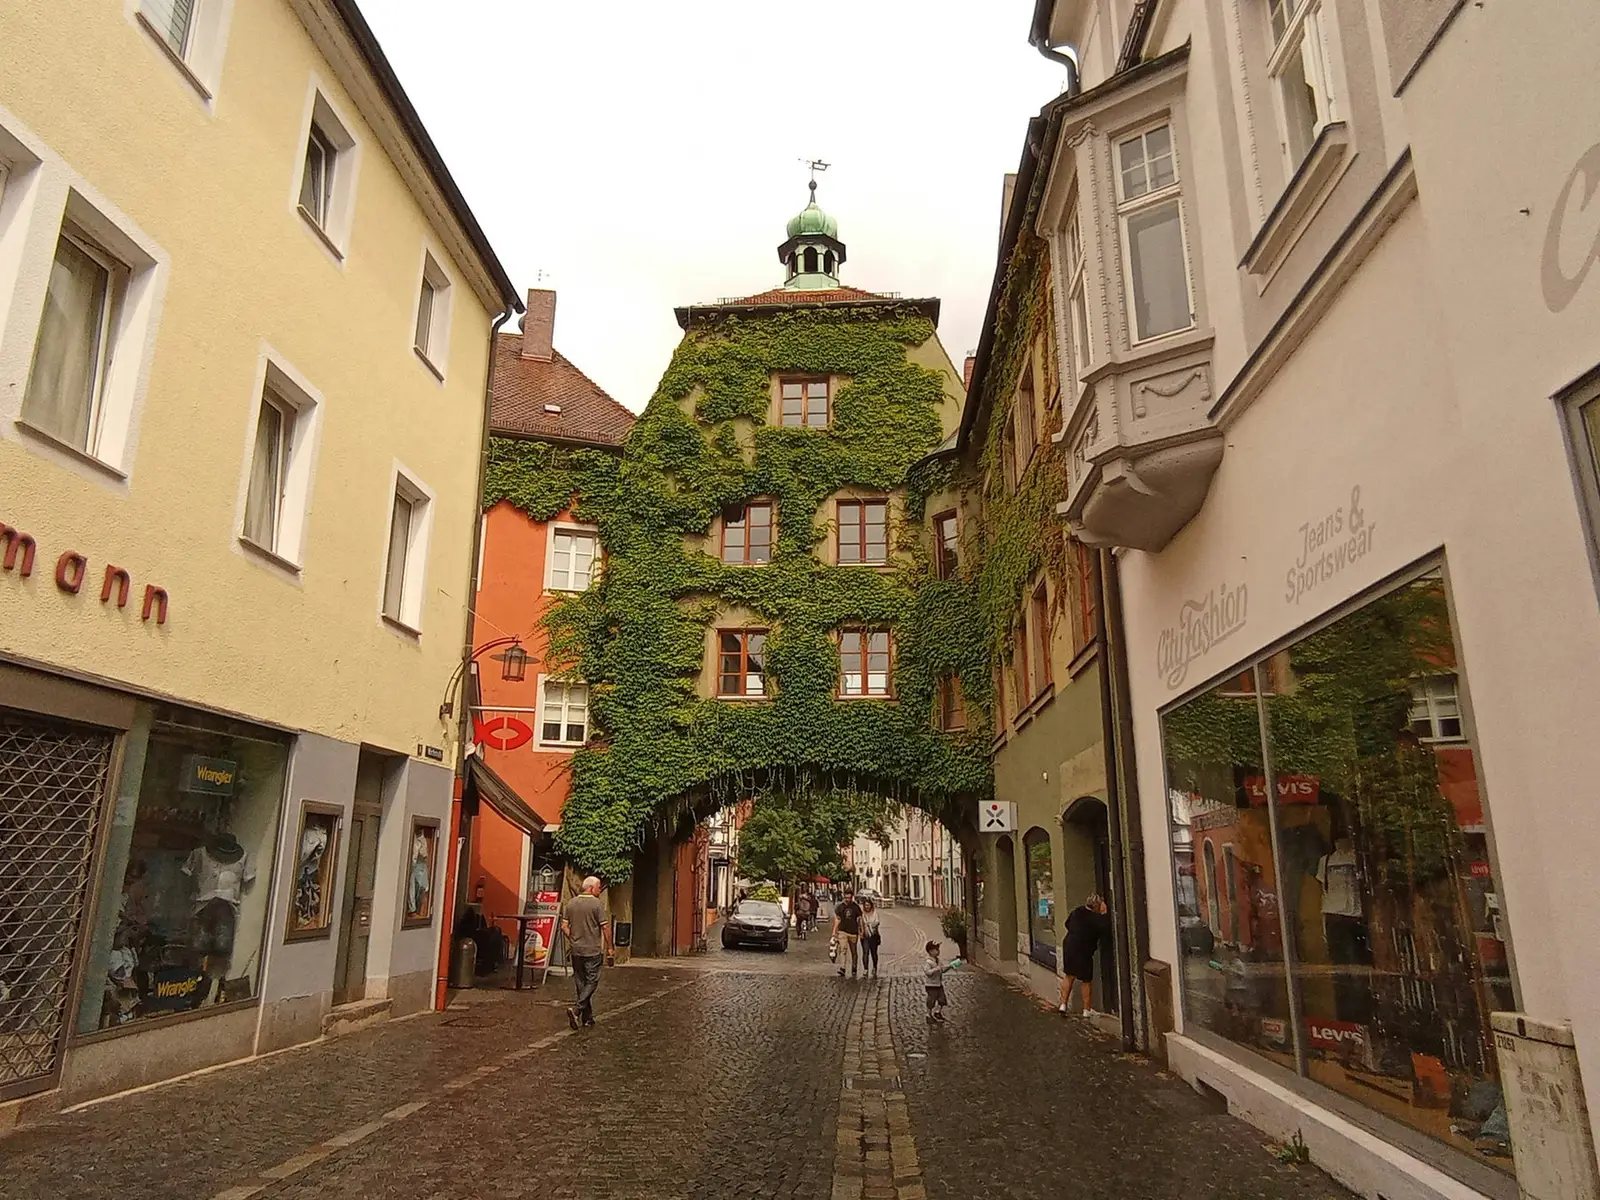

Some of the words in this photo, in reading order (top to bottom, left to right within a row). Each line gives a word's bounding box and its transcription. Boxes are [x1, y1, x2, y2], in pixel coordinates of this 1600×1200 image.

[1285, 521, 1377, 605] Sportswear
[1296, 507, 1343, 569] Jeans
[1349, 484, 1364, 534] &
[197, 764, 233, 786] Wrangler
